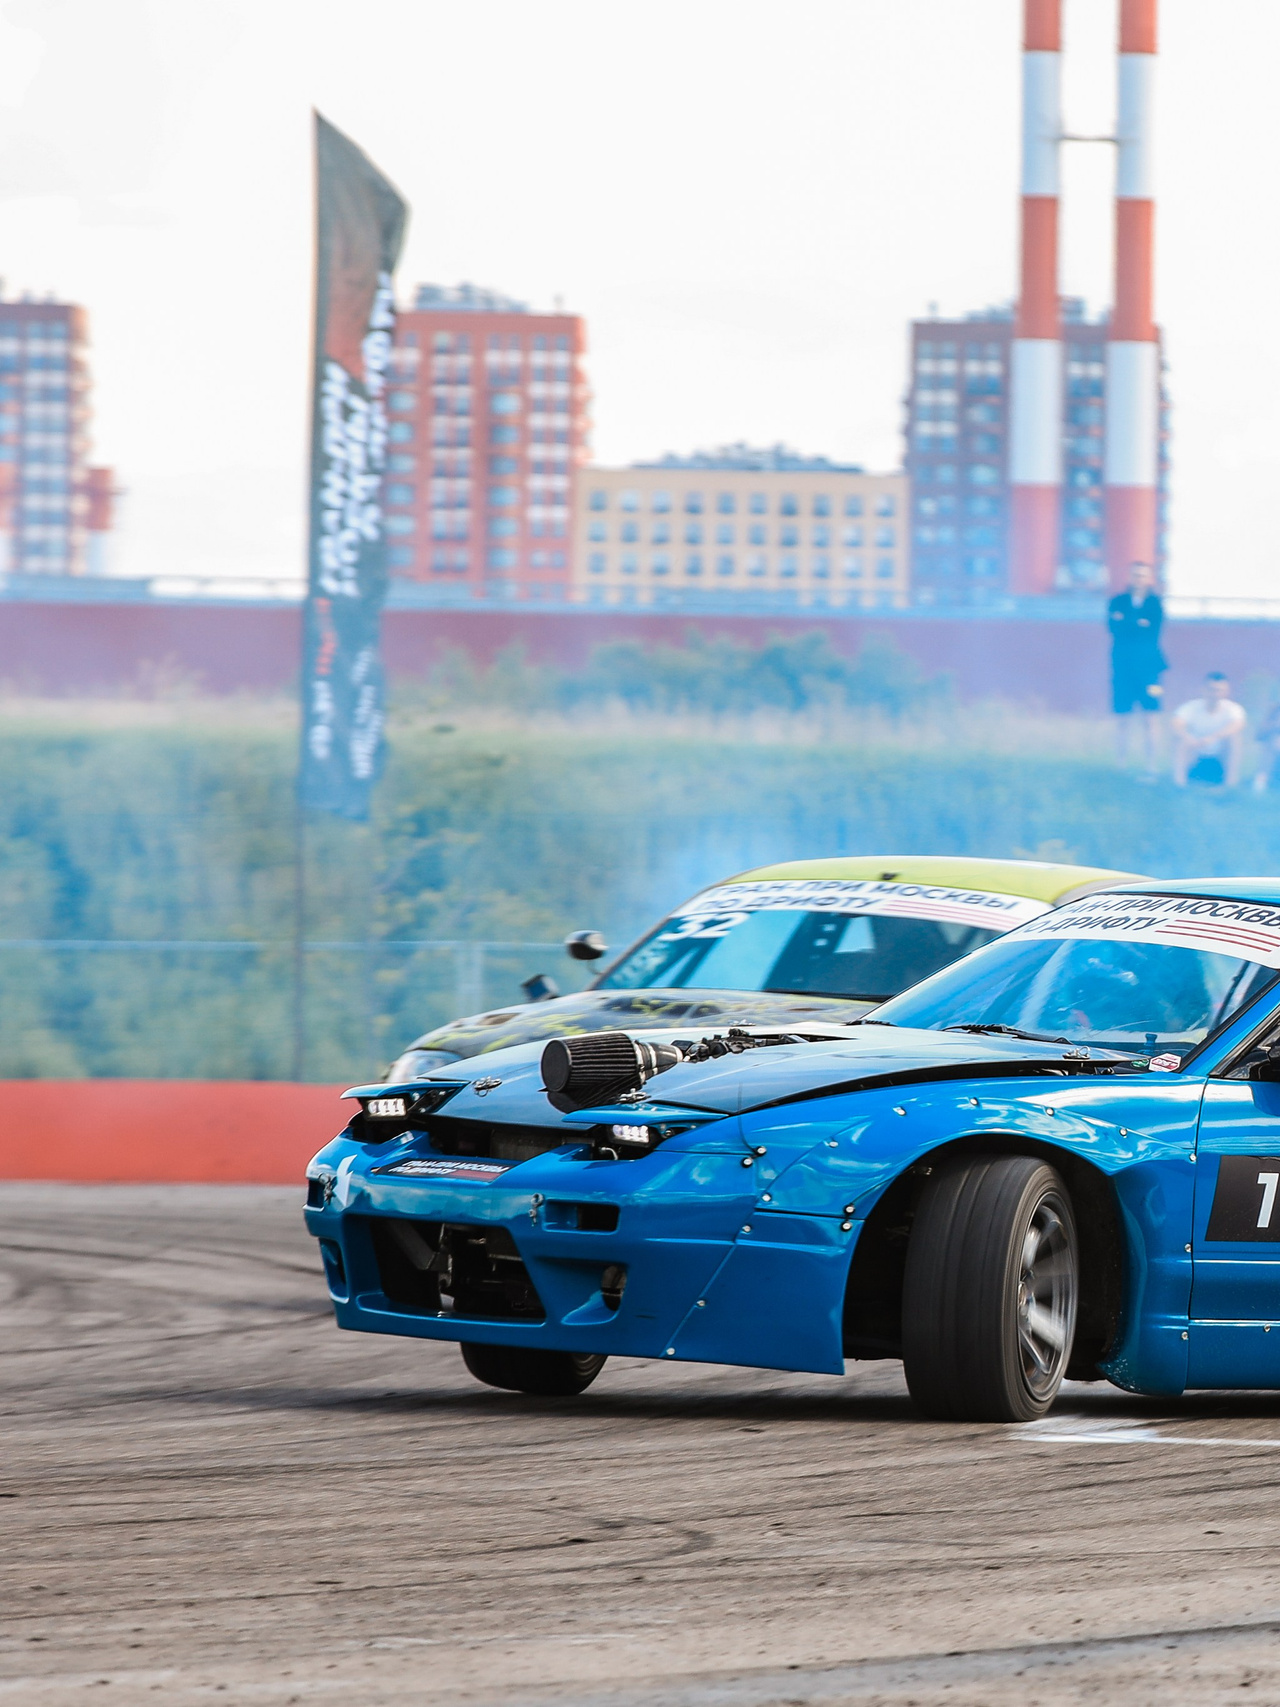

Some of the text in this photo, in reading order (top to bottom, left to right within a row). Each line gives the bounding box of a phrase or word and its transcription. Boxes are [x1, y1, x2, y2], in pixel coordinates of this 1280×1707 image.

[740, 897, 882, 910] ДРИФТУ
[871, 883, 1022, 910] МОСКВЫ
[1050, 897, 1168, 916] АН-ПРИ
[659, 911, 753, 941] 32
[1038, 914, 1169, 933] ДРИФТУ
[1256, 1172, 1280, 1228] 1
